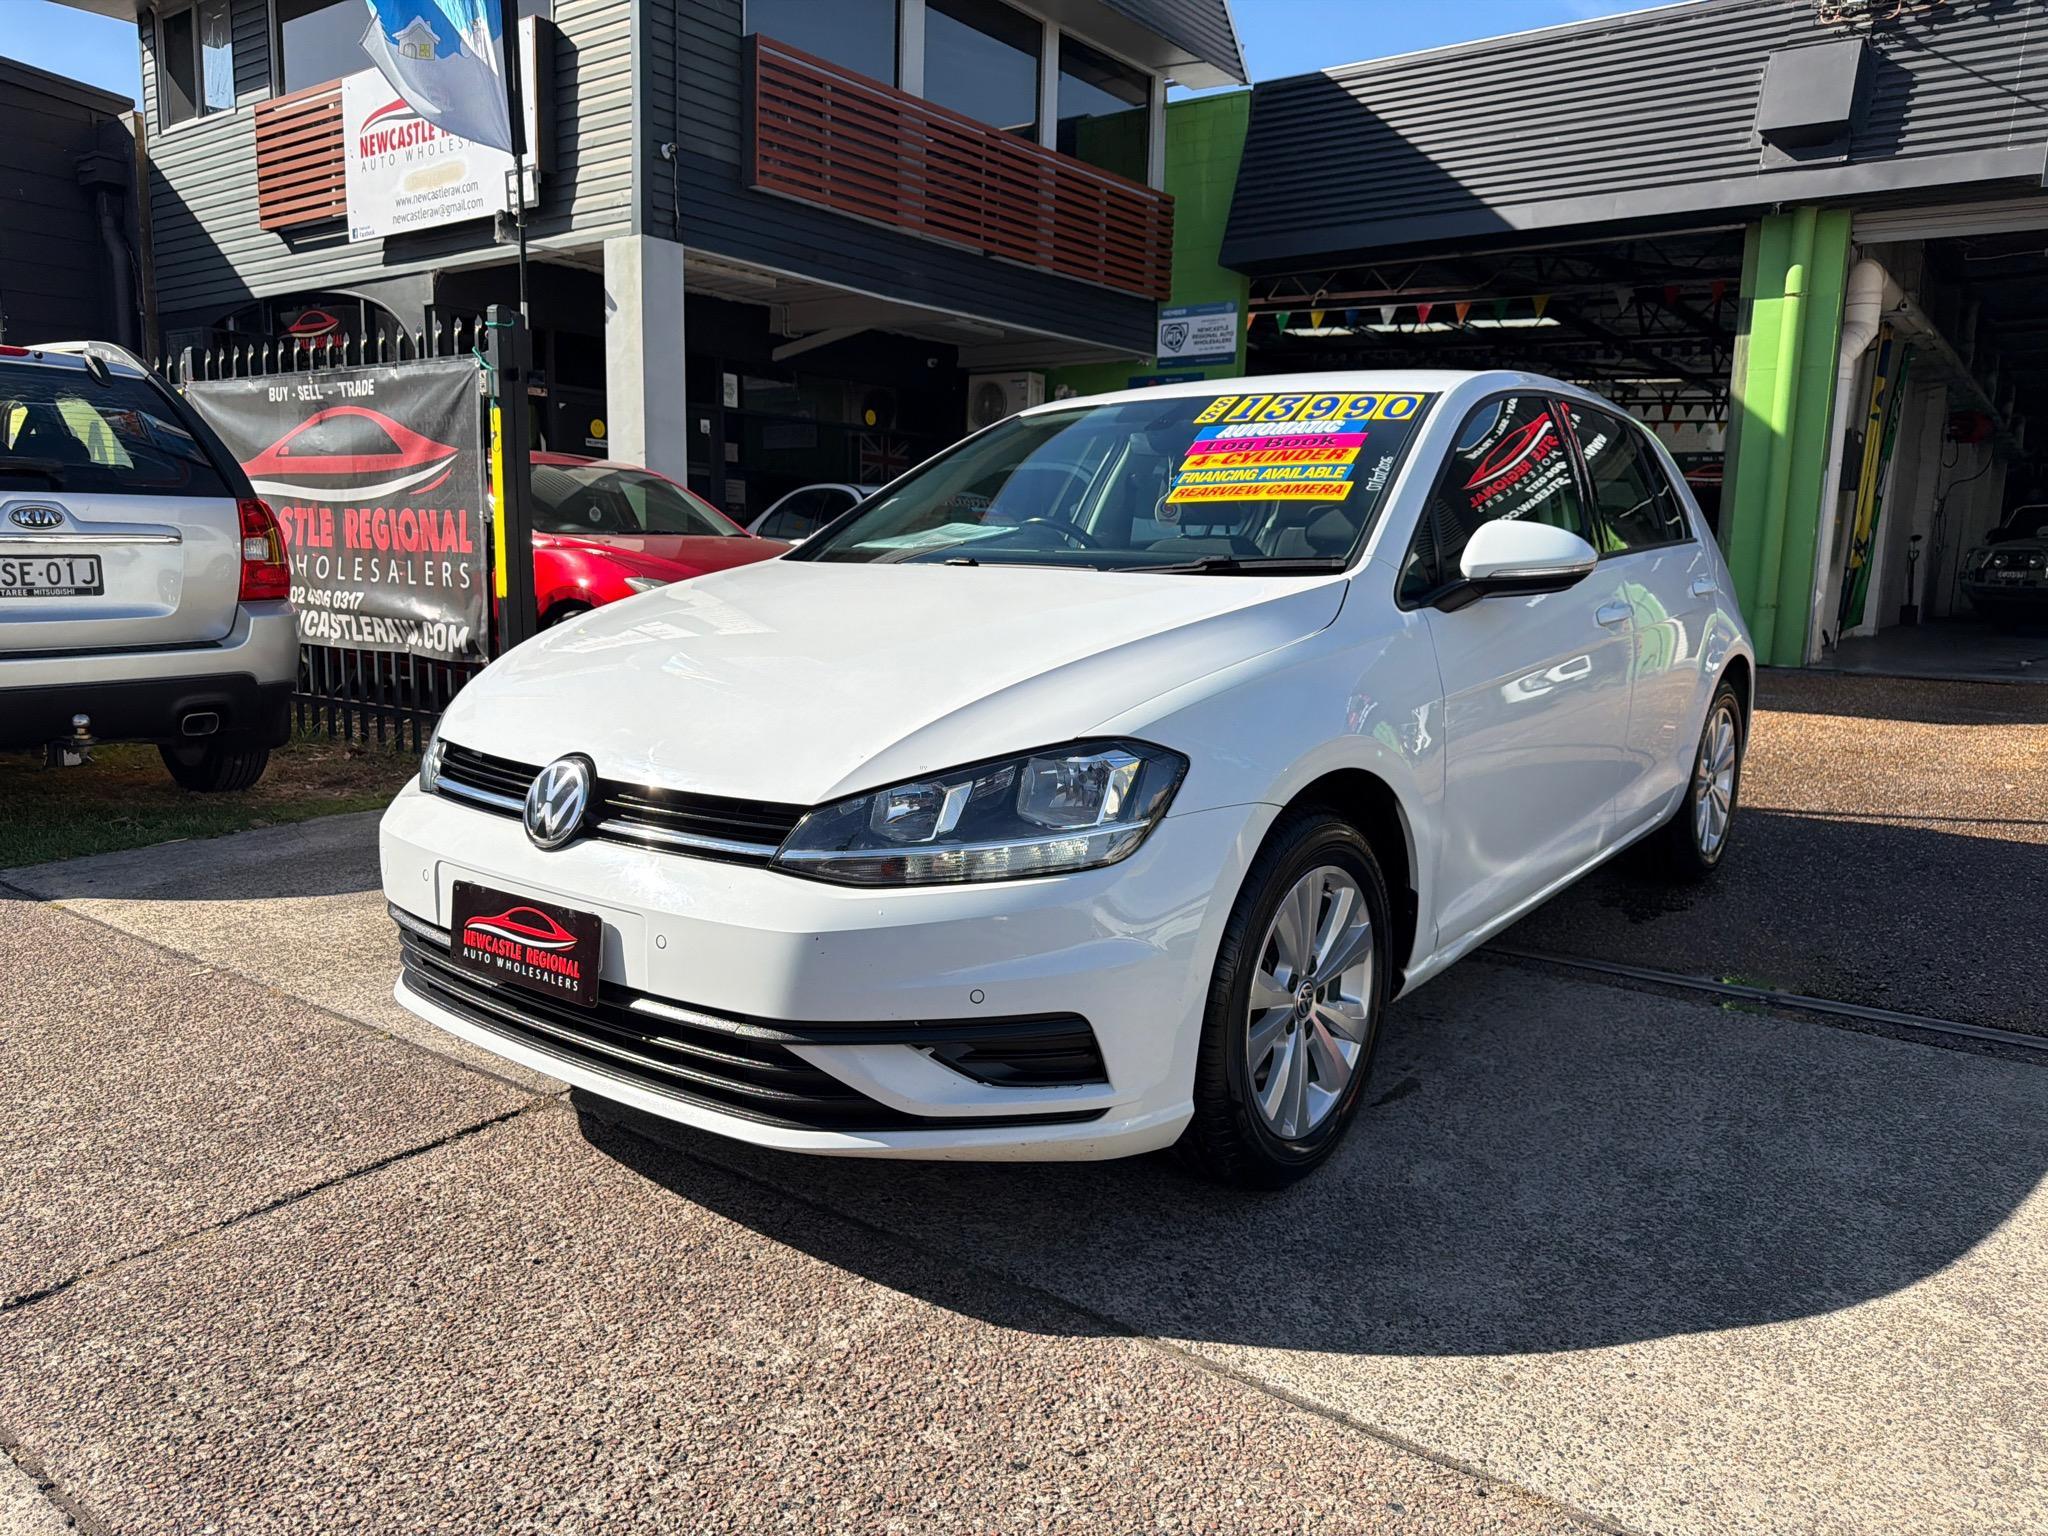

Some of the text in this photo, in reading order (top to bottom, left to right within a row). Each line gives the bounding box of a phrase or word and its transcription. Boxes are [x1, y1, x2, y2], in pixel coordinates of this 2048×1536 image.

[360, 121, 435, 158] NEWCASTLE
[361, 153, 396, 173] AUTO
[395, 181, 479, 207] www.newcastleraw.com
[392, 197, 484, 225] newcastleraw@gmail.com
[268, 379, 375, 402] BUY SELL TRADE
[1215, 419, 1346, 439] AUTOMATIC
[1263, 435, 1338, 449] Book
[1190, 448, 1350, 466] 4-CYLINDER
[1178, 466, 1348, 484] FINANCING AVAILABLE
[1175, 483, 1346, 498] REARVIEW CAMERA
[19, 510, 57, 524] KIA
[344, 507, 473, 553] REGIONAL
[289, 553, 470, 589] HOLESALERS
[0, 587, 76, 597] TAREE MITSUBISHI
[290, 586, 305, 604] 02
[333, 590, 365, 610] 0317
[463, 929, 580, 979] NEWCASTLE REGIONAL
[463, 947, 579, 992] AUTO WHOLESALERS
